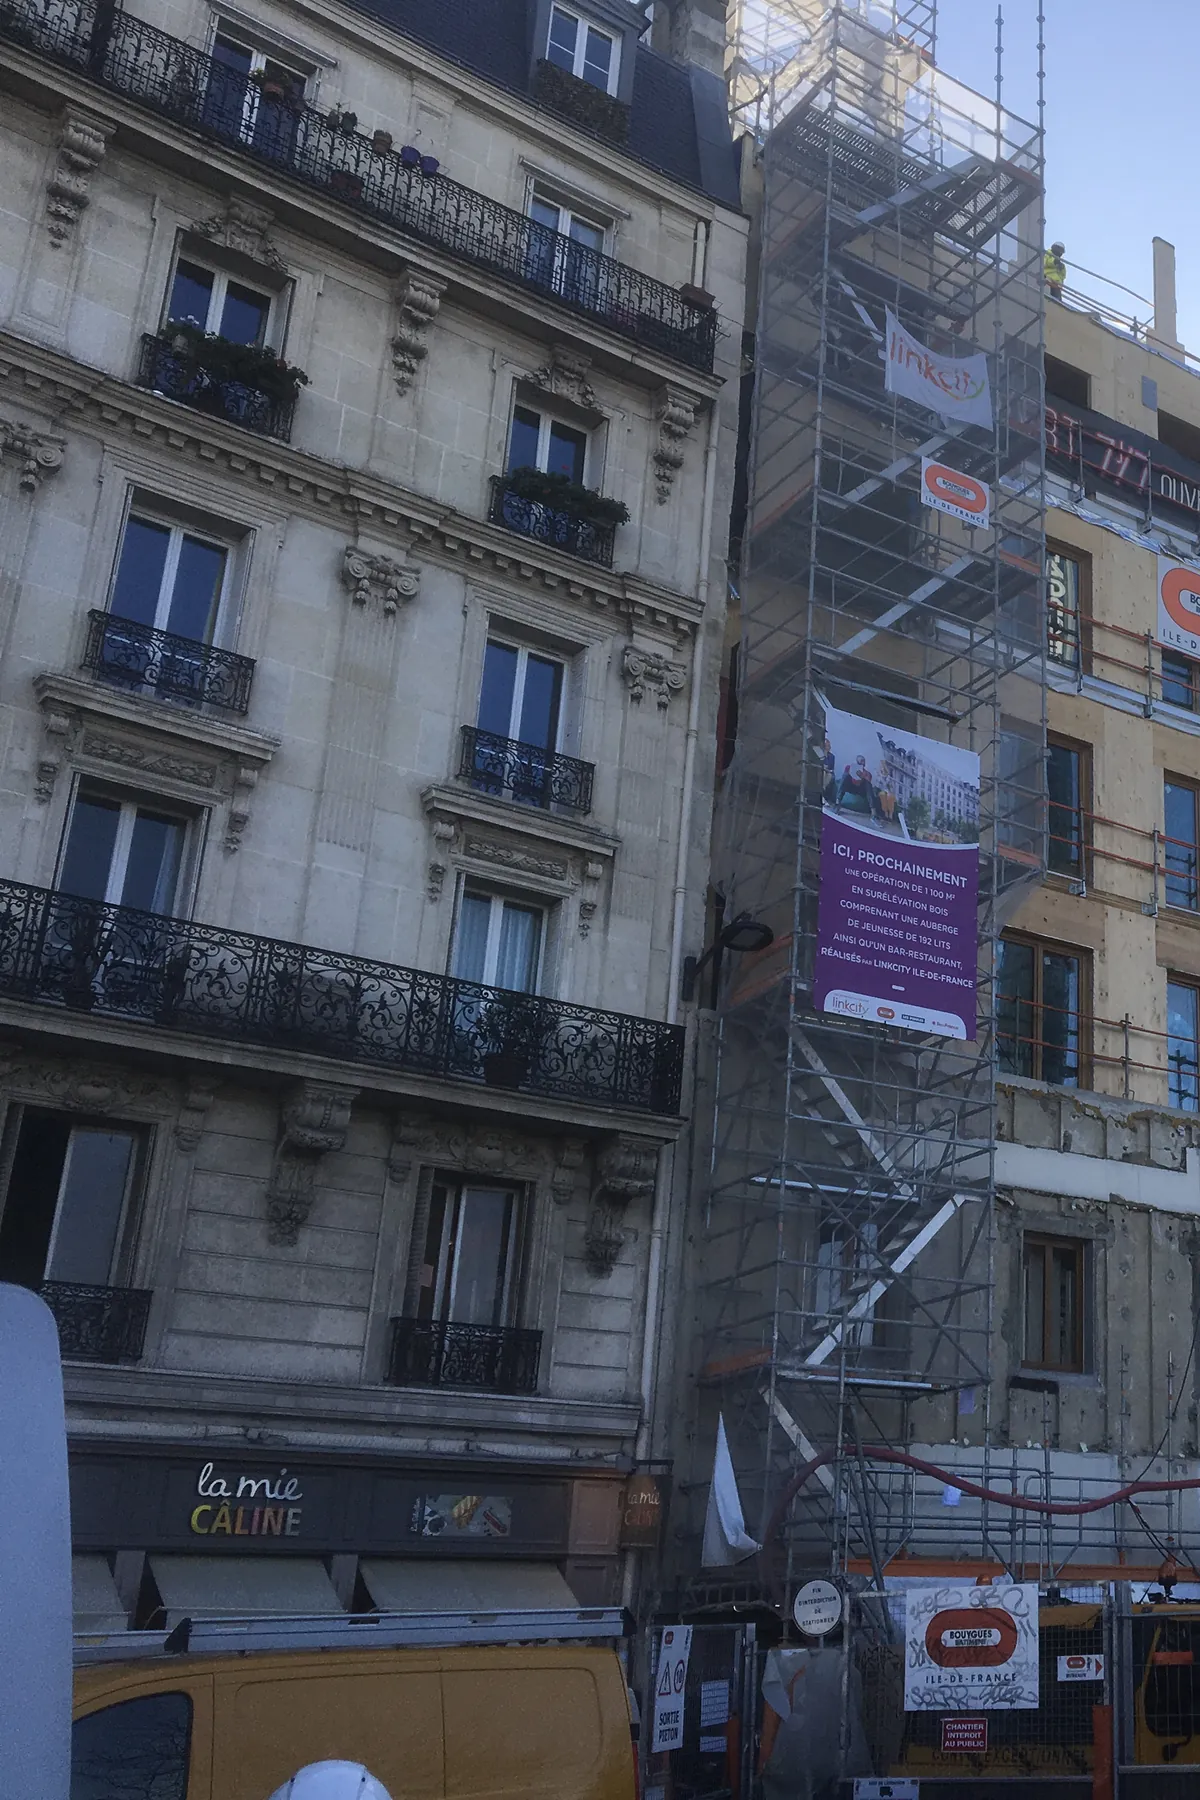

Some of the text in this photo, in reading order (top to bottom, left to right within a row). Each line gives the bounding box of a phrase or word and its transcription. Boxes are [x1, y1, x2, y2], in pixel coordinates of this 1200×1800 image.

[890, 332, 985, 401] linkcity
[833, 843, 968, 889] ICI, PROCHAINEMENT
[844, 868, 860, 878] UNE
[861, 870, 910, 890] OPÉRATION
[911, 884, 923, 893] DE
[851, 885, 949, 917] EN SURÉLÉVATION BOIS
[840, 899, 959, 936] COMPRENANT UNE AUBERGE
[847, 918, 951, 950] DE JEUNESSE DE 192 LITS
[821, 946, 974, 989] RÉALISÉS PAR LINKCITY ILE-DE-FRANCE
[833, 933, 963, 971] AINSI QU'UN BAR-RESTAURANT,
[832, 996, 870, 1015] linkcity
[198, 1462, 303, 1500] la mie
[639, 1485, 661, 1505] mie
[190, 1500, 303, 1536] CÂLINE
[949, 1630, 993, 1639] BOUYGUES
[926, 1673, 1017, 1684] ILE-DE-FRANCE
[659, 1710, 680, 1726] SORTIE
[658, 1727, 679, 1743] PIETON
[944, 1740, 956, 1748] AU
